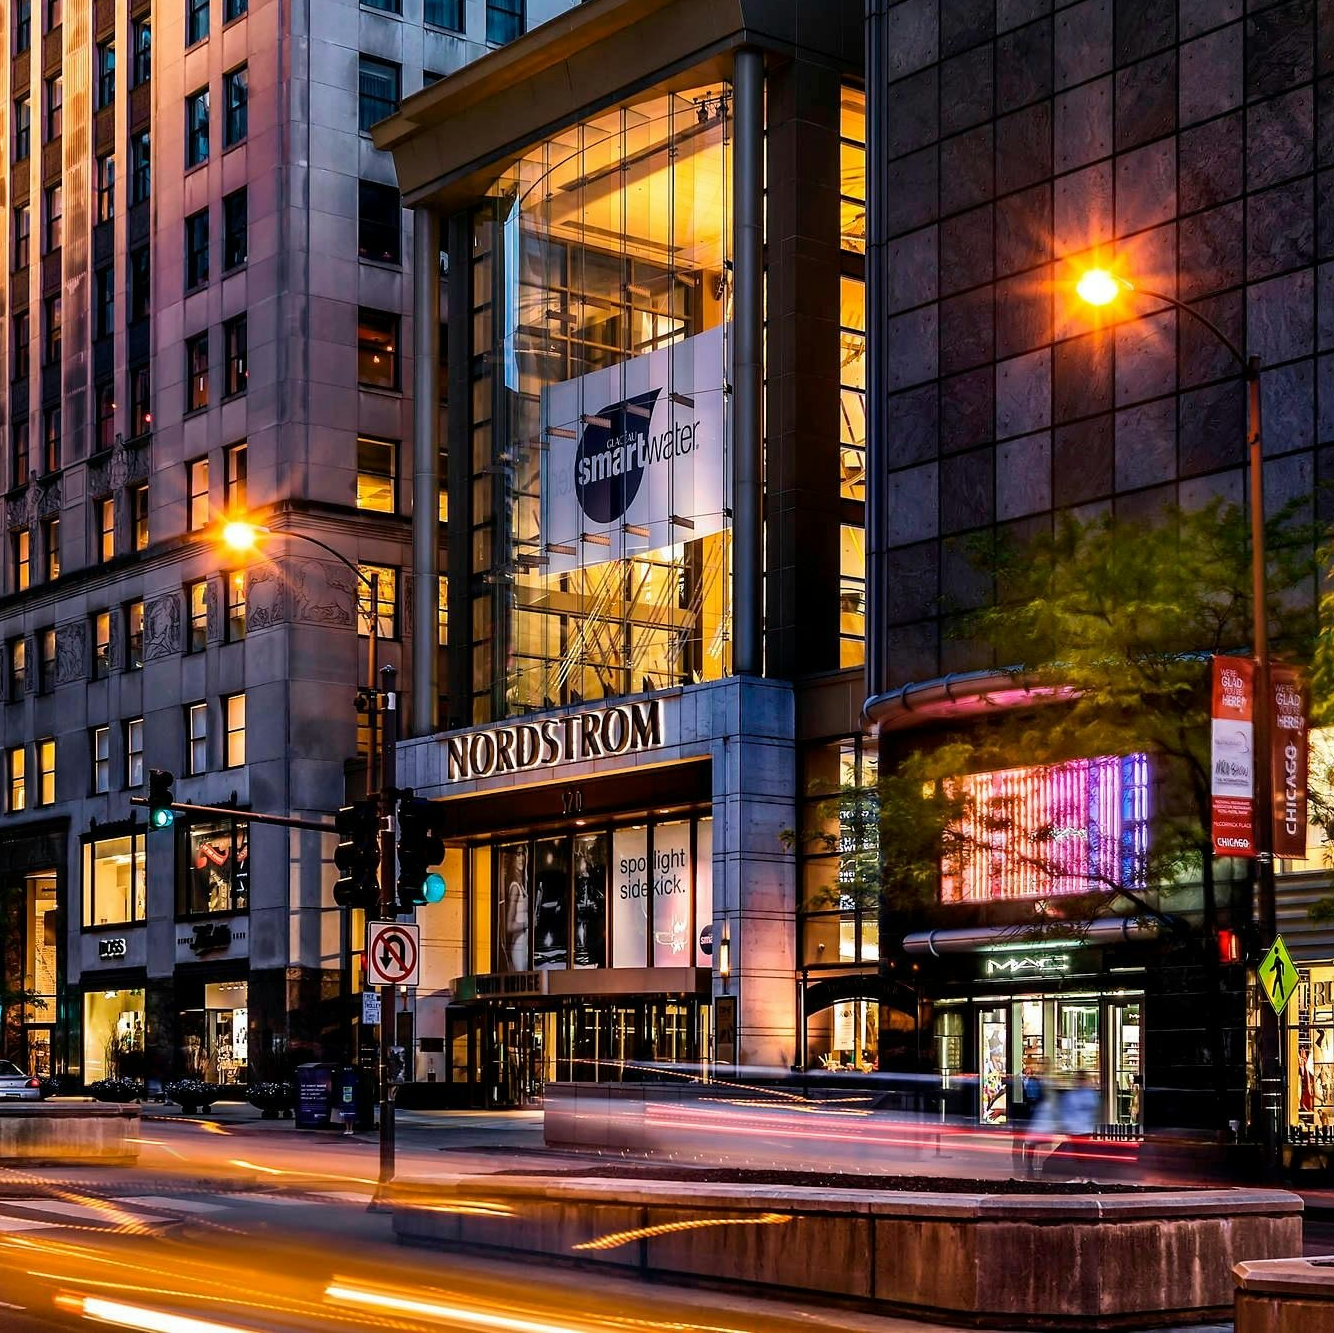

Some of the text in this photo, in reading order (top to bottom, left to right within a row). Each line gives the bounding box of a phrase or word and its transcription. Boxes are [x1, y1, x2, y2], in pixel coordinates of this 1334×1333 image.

[1221, 676, 1243, 689] GLAD
[1275, 692, 1301, 706] GLAD
[447, 700, 662, 780] NORDSTROM
[1284, 741, 1297, 835] CHICAGO
[1217, 837, 1250, 848] CHICAGO
[620, 848, 686, 877] spolight
